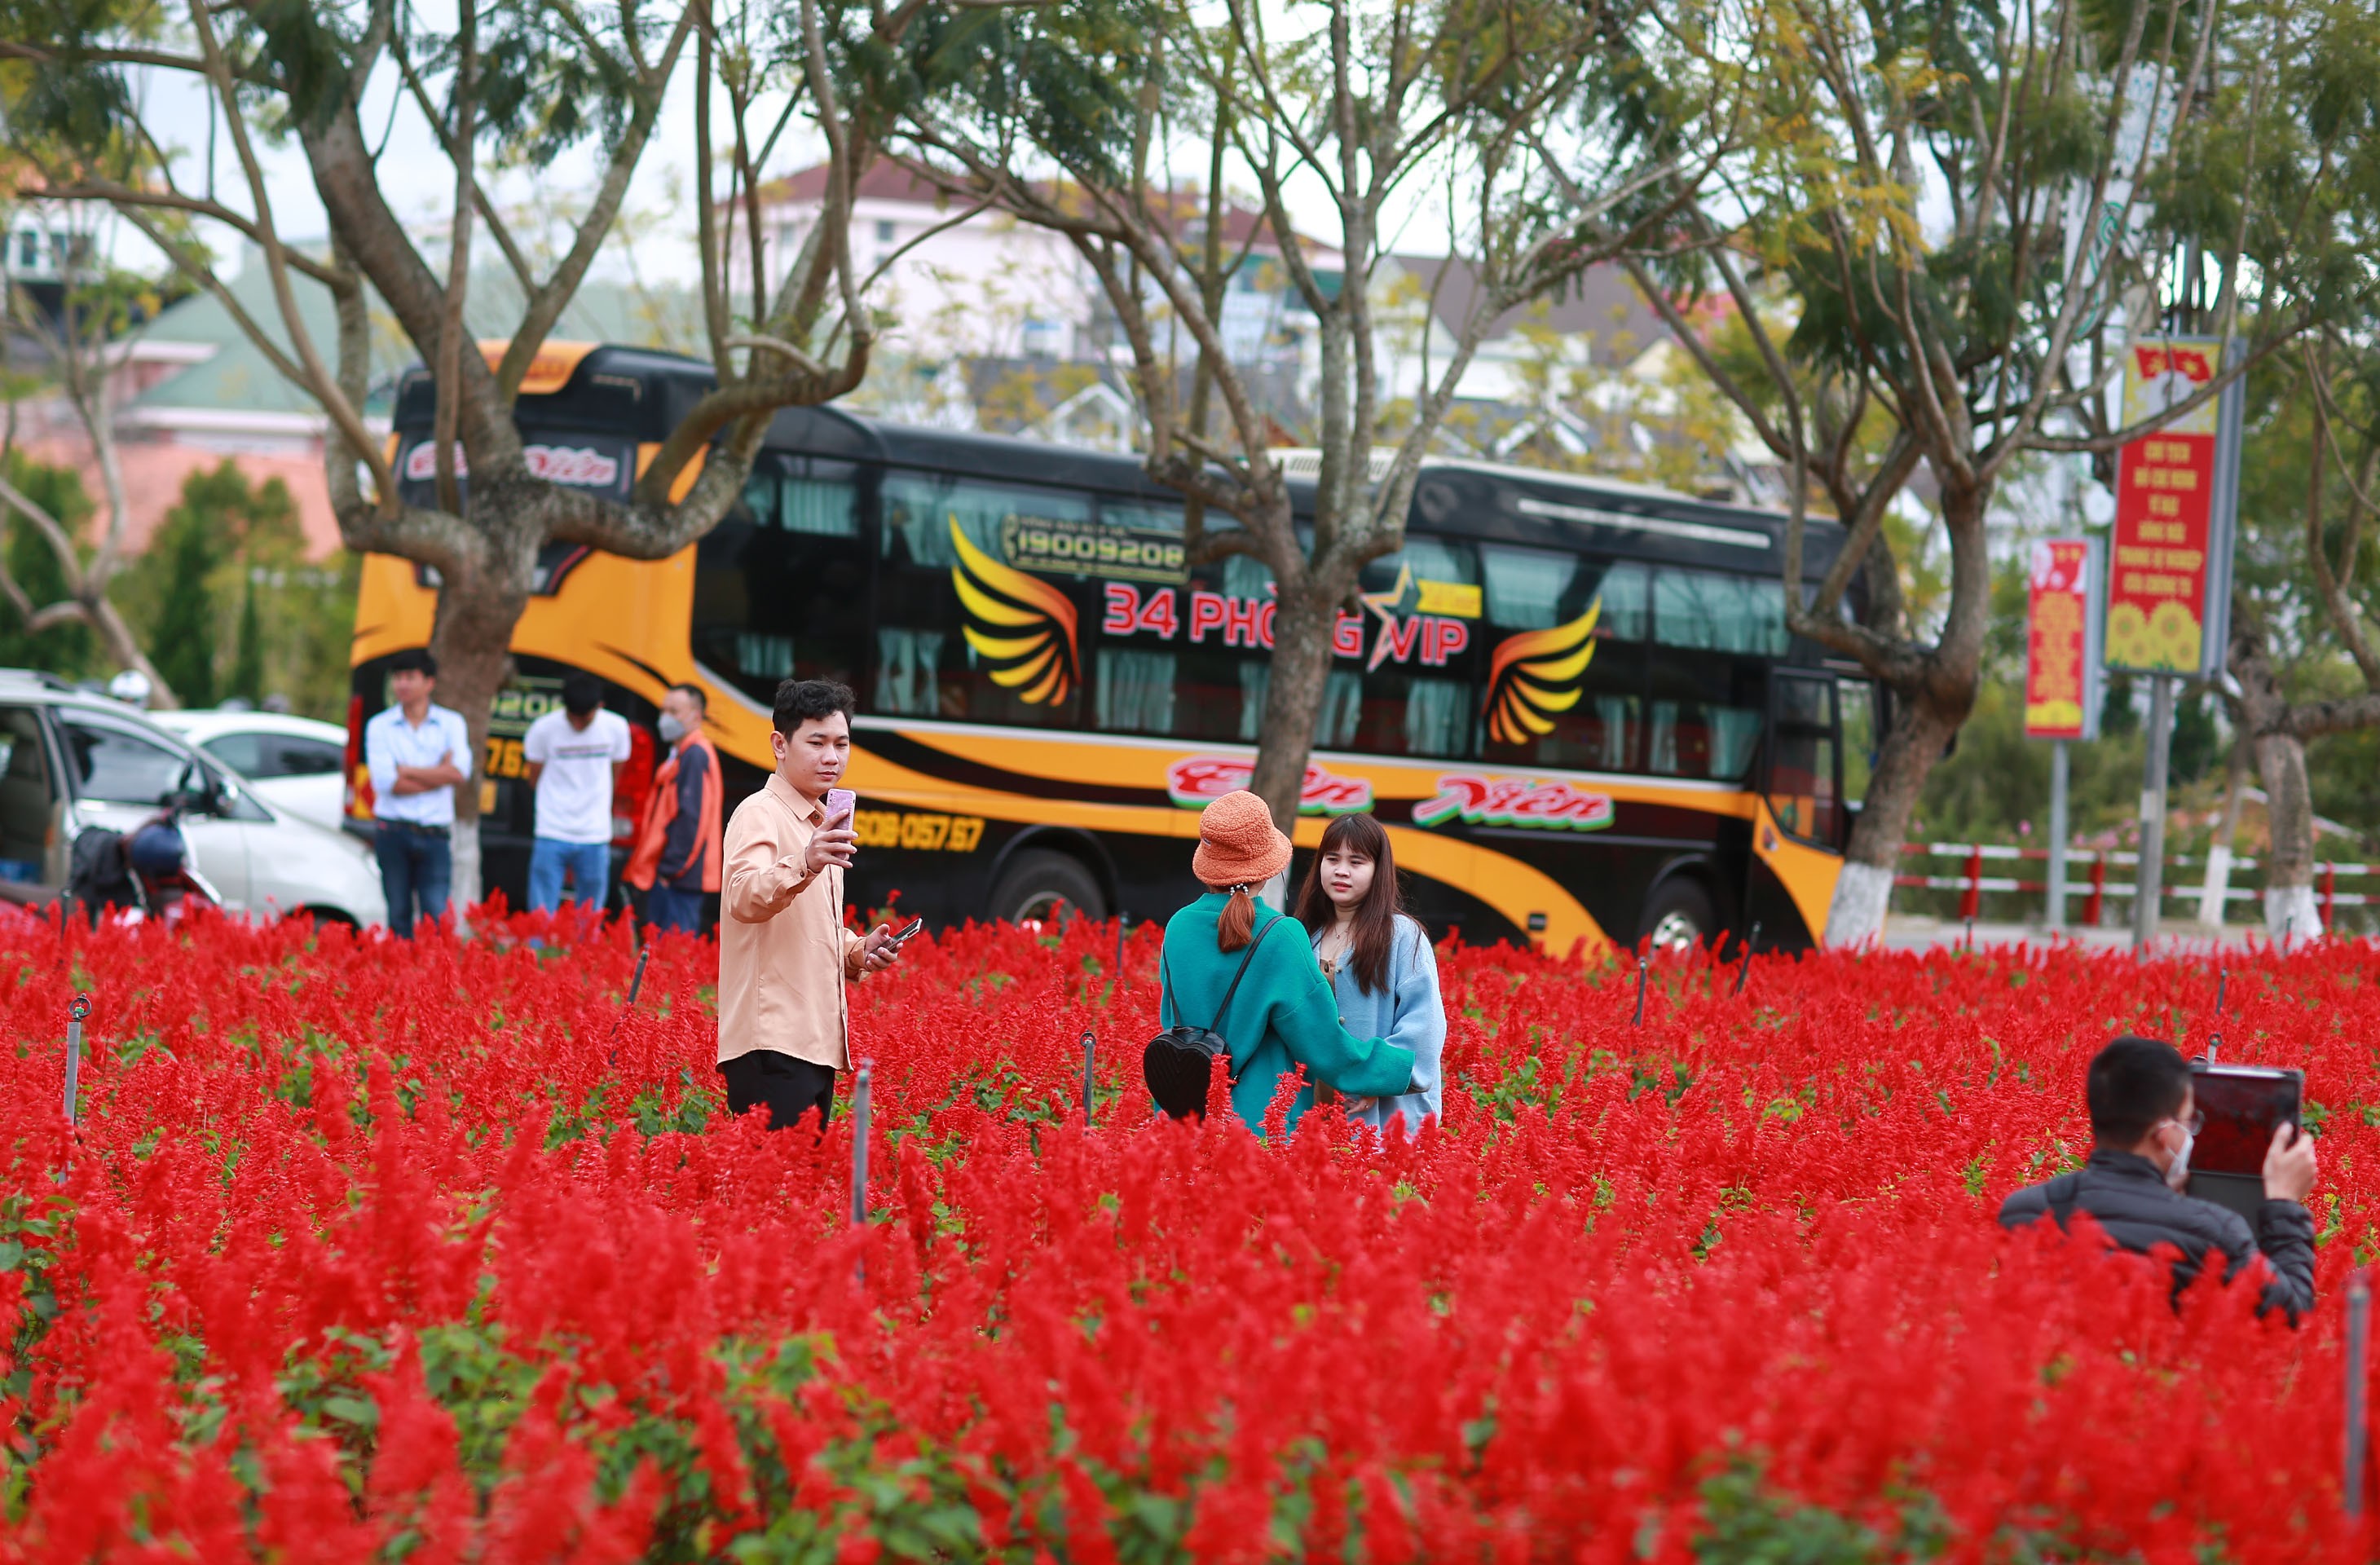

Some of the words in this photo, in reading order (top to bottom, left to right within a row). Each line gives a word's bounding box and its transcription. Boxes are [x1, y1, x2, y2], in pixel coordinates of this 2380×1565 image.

[1019, 529, 1185, 569] 19009208
[1103, 581, 1179, 640] 34
[1189, 581, 1364, 659] PHÒG
[1388, 615, 1469, 667] VIP
